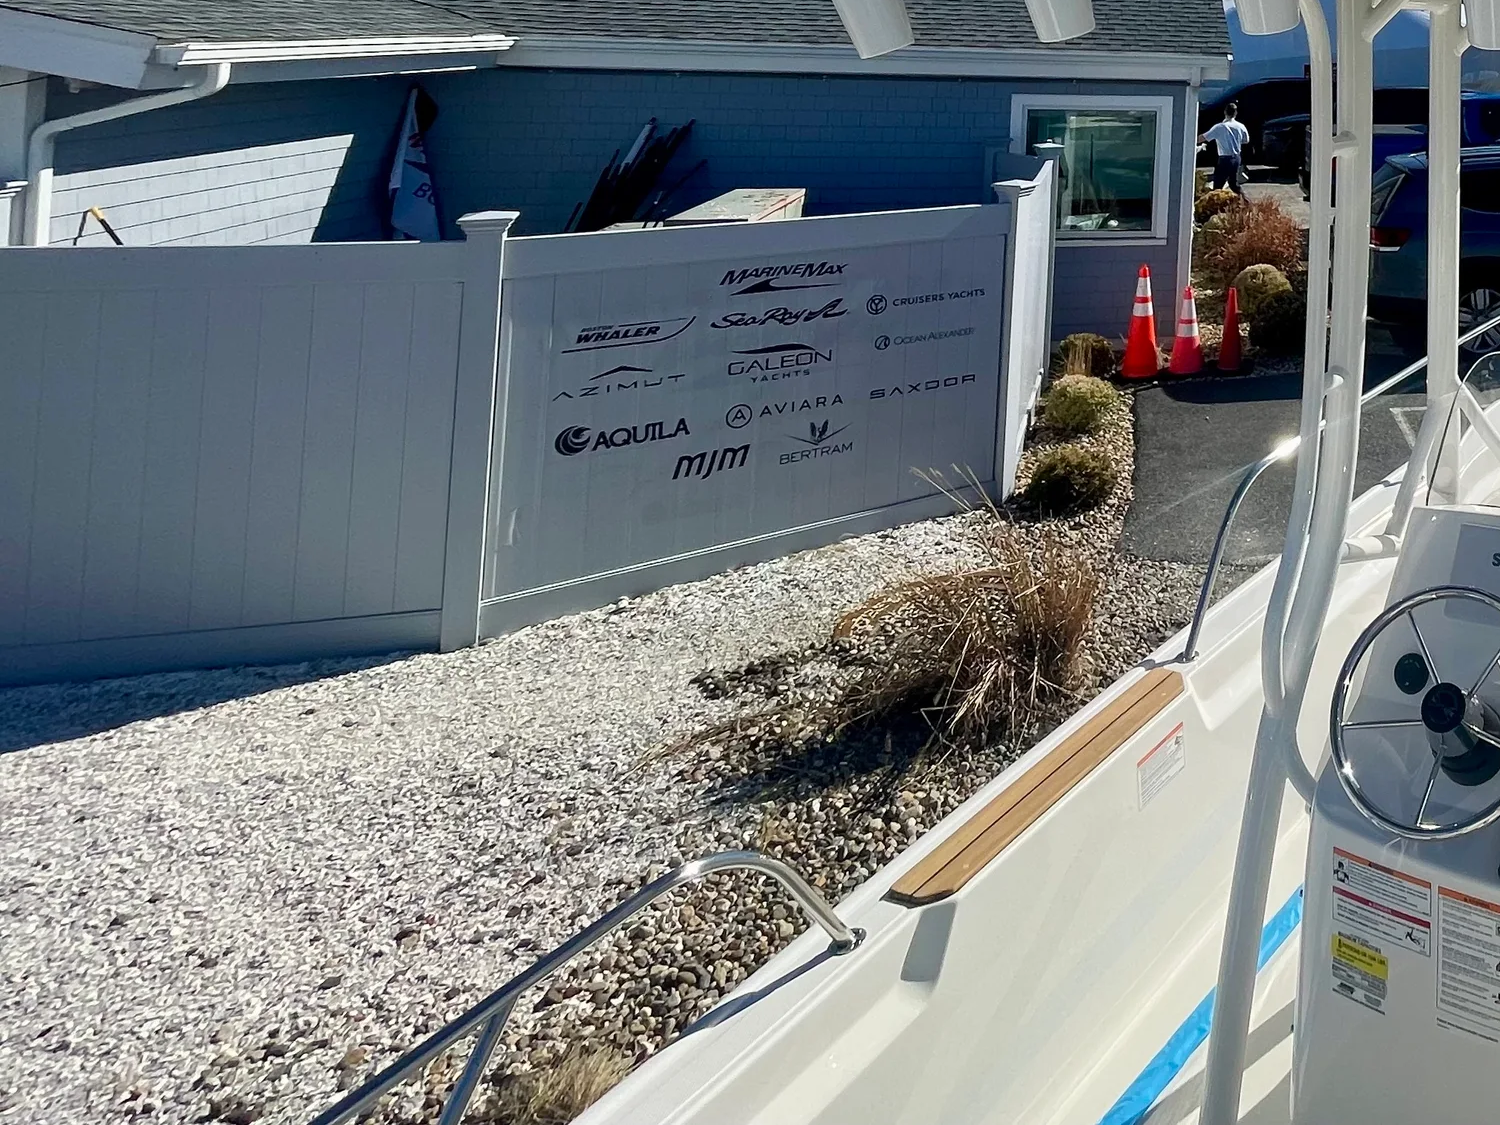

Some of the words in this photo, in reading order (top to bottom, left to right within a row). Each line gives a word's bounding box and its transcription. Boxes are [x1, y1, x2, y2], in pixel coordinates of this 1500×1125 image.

[892, 293, 945, 307] CRUISERS
[947, 288, 986, 300] YACHTS
[710, 312, 764, 329] Sea
[576, 326, 661, 344] WHALER
[893, 335, 928, 346] OCEAN
[926, 327, 975, 342] ALEXANDER
[728, 349, 833, 376] GALEON
[750, 368, 811, 383] YACHTS
[869, 374, 976, 399] SAXDOR
[552, 374, 686, 402] AZIMUT
[759, 394, 844, 418] AVIARA
[592, 418, 691, 452] AQUILA
[779, 442, 853, 466] BERTRAM
